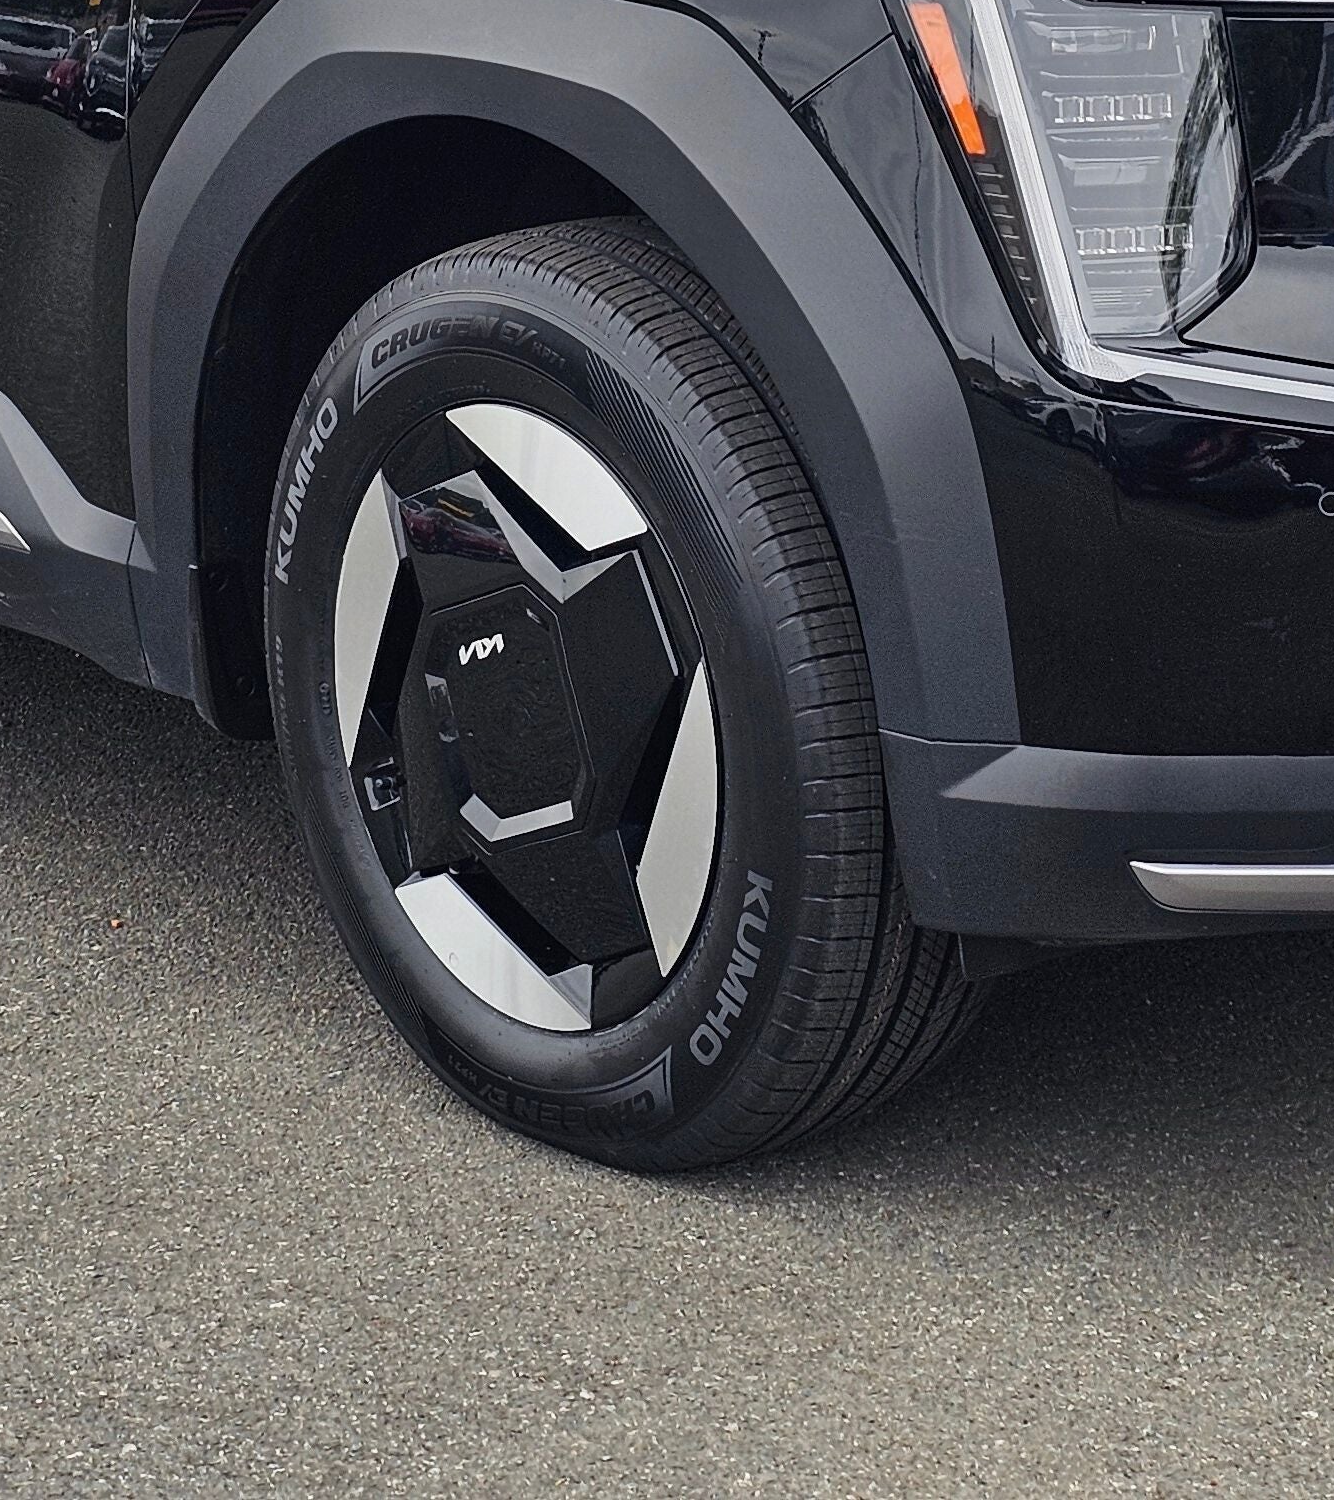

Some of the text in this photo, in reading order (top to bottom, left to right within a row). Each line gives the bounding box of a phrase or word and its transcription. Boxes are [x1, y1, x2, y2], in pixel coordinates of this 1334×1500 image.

[371, 315, 500, 370] CRUGEN
[275, 398, 339, 585] KUMHO
[458, 633, 505, 666] KIA
[689, 869, 773, 1066] KUMHO
